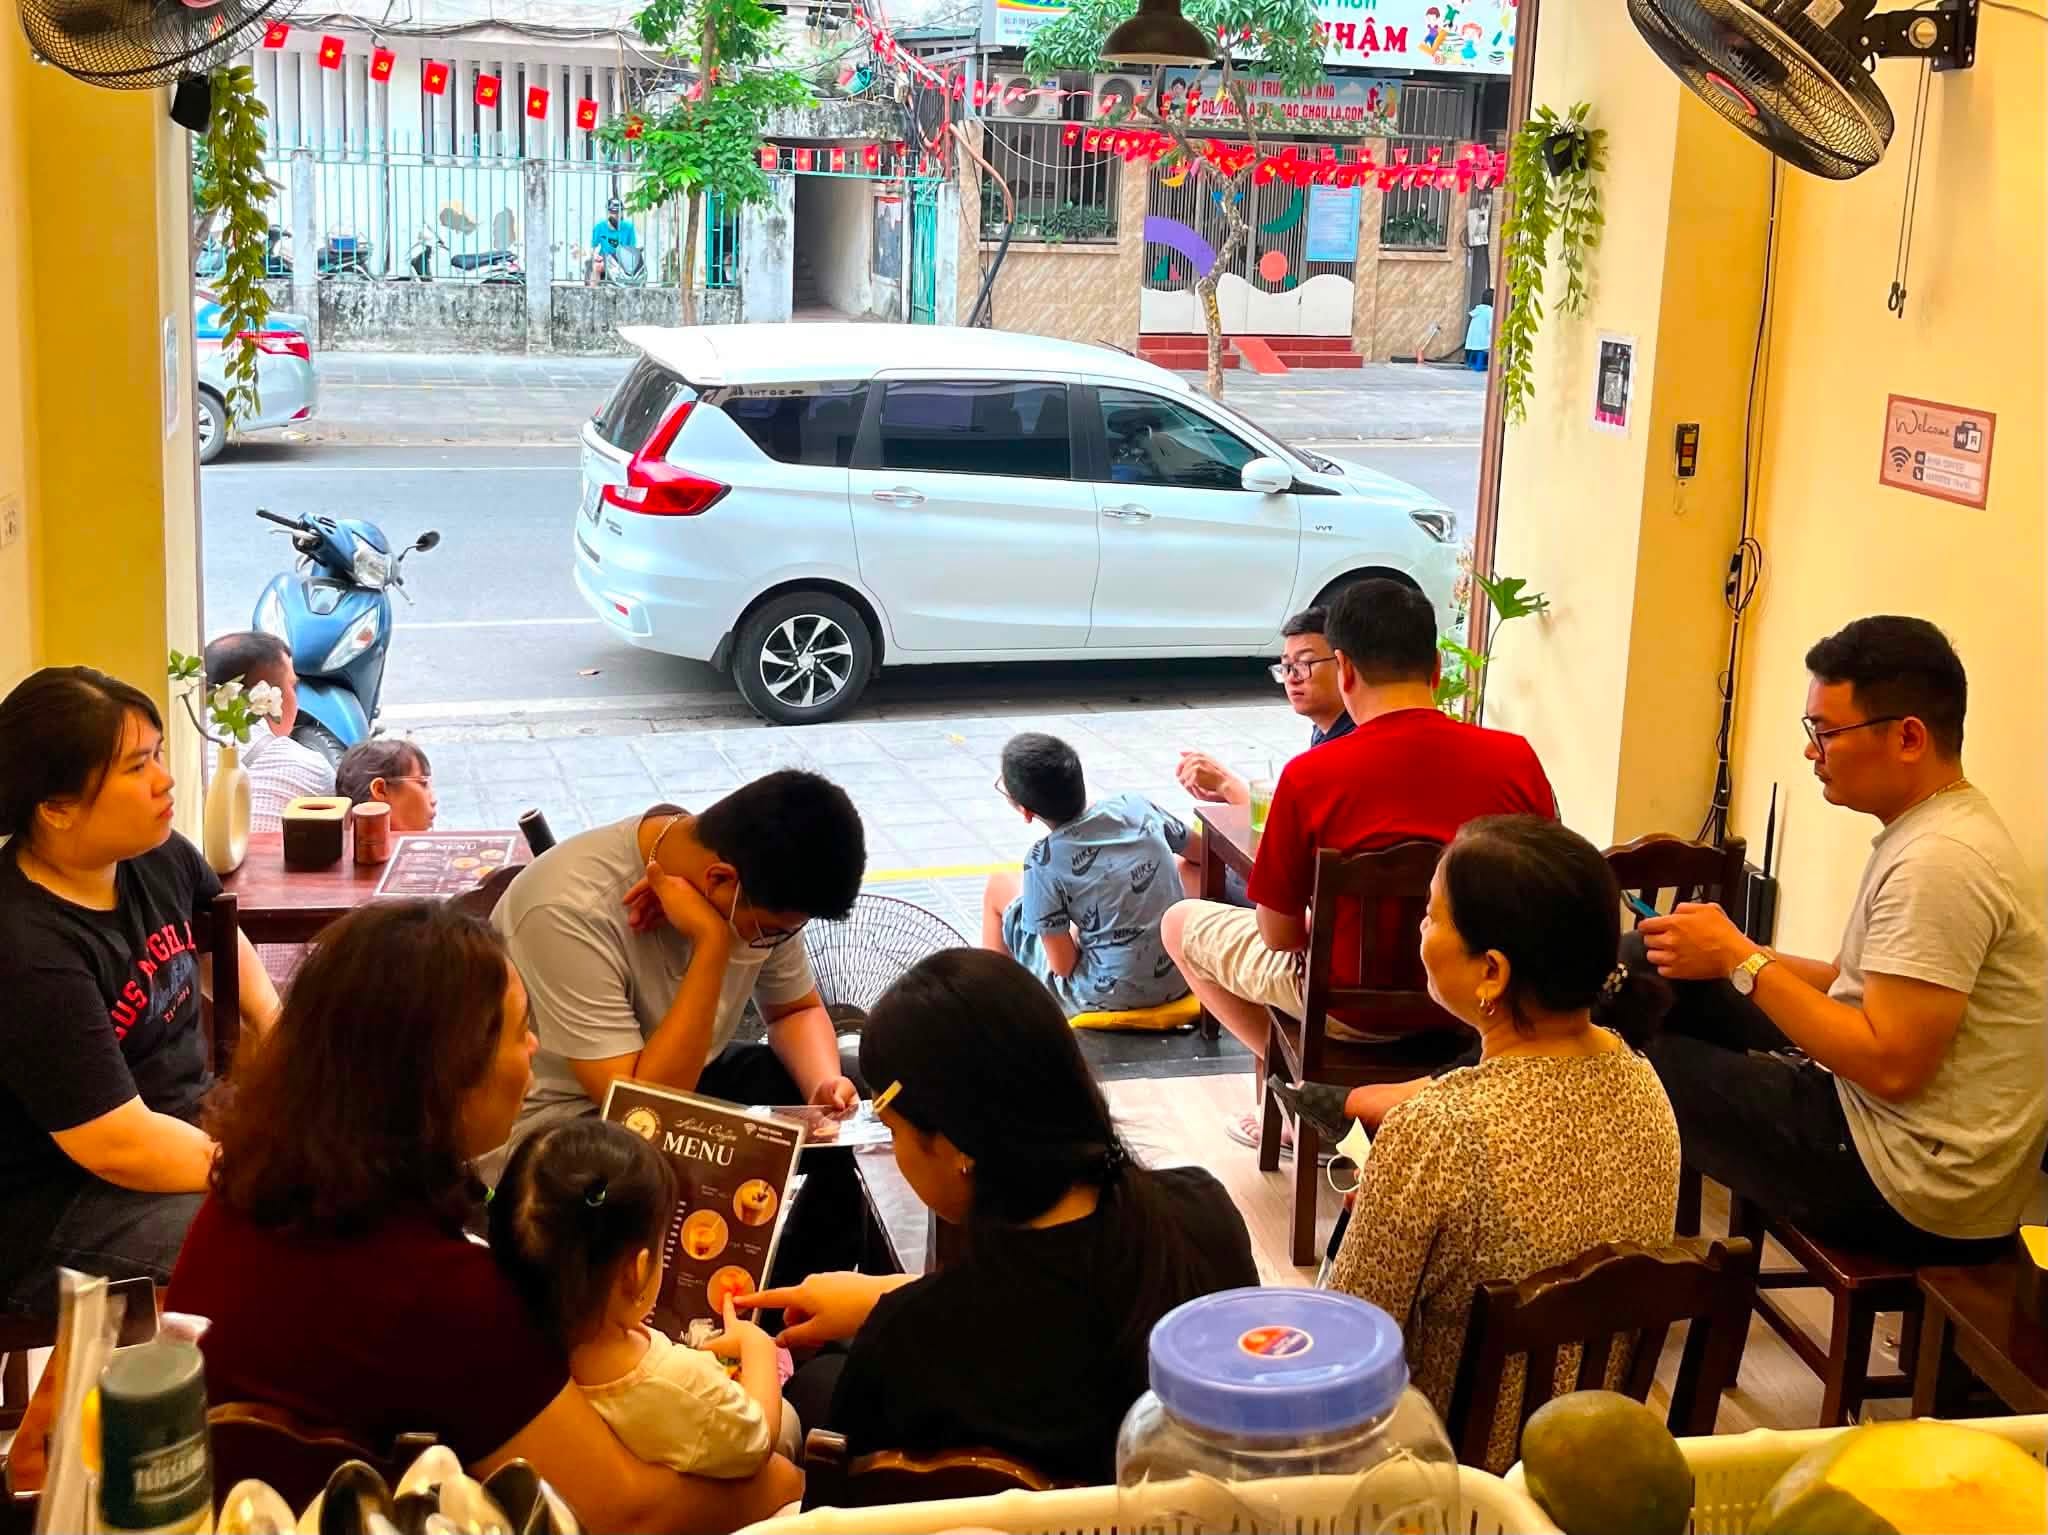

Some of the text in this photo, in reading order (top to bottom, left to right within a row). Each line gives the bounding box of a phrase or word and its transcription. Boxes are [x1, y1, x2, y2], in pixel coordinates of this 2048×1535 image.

[1895, 409, 1951, 437] Welcome
[1072, 847, 1097, 866] NIKE
[1130, 859, 1154, 880] NIKE
[662, 1131, 735, 1166] MENU
